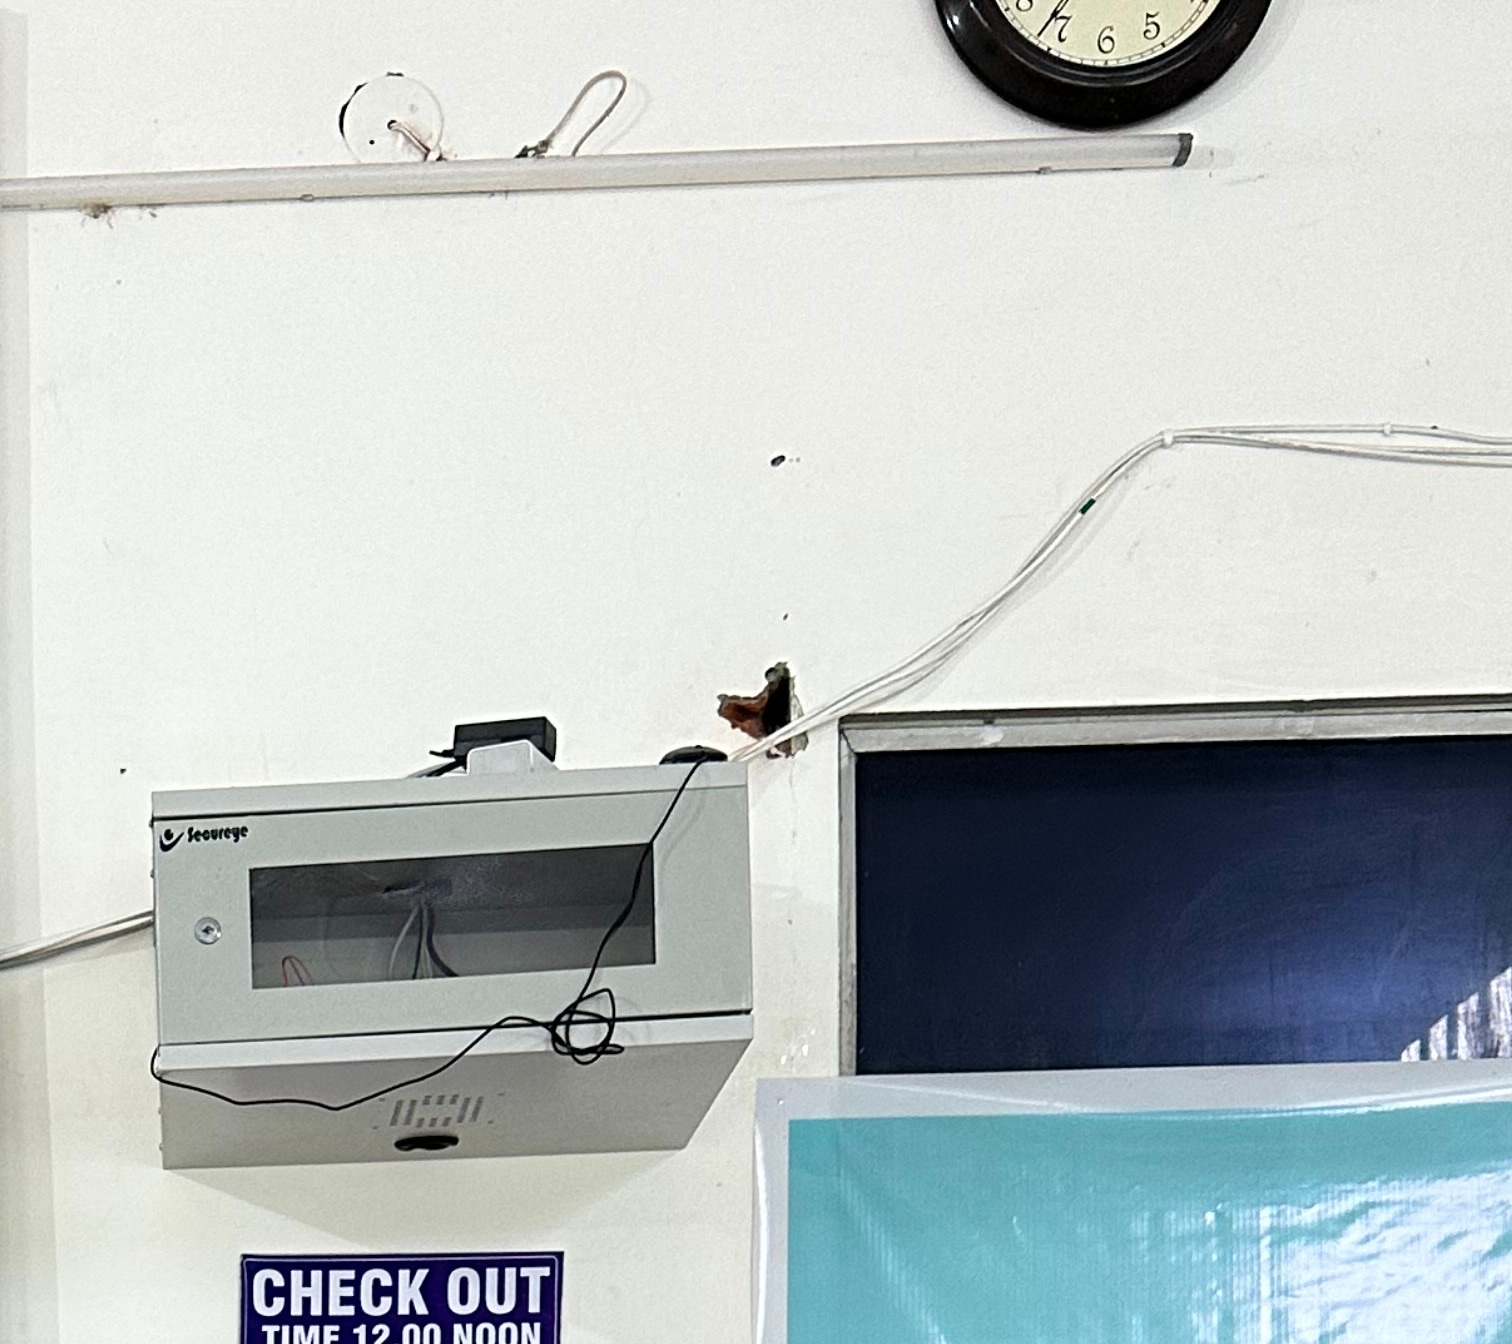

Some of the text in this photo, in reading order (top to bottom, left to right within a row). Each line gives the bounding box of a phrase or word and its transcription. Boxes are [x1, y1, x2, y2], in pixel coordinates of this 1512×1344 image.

[1097, 26, 1115, 54] 6
[1143, 12, 1160, 40] 5
[252, 1266, 551, 1317] CHECK OUT
